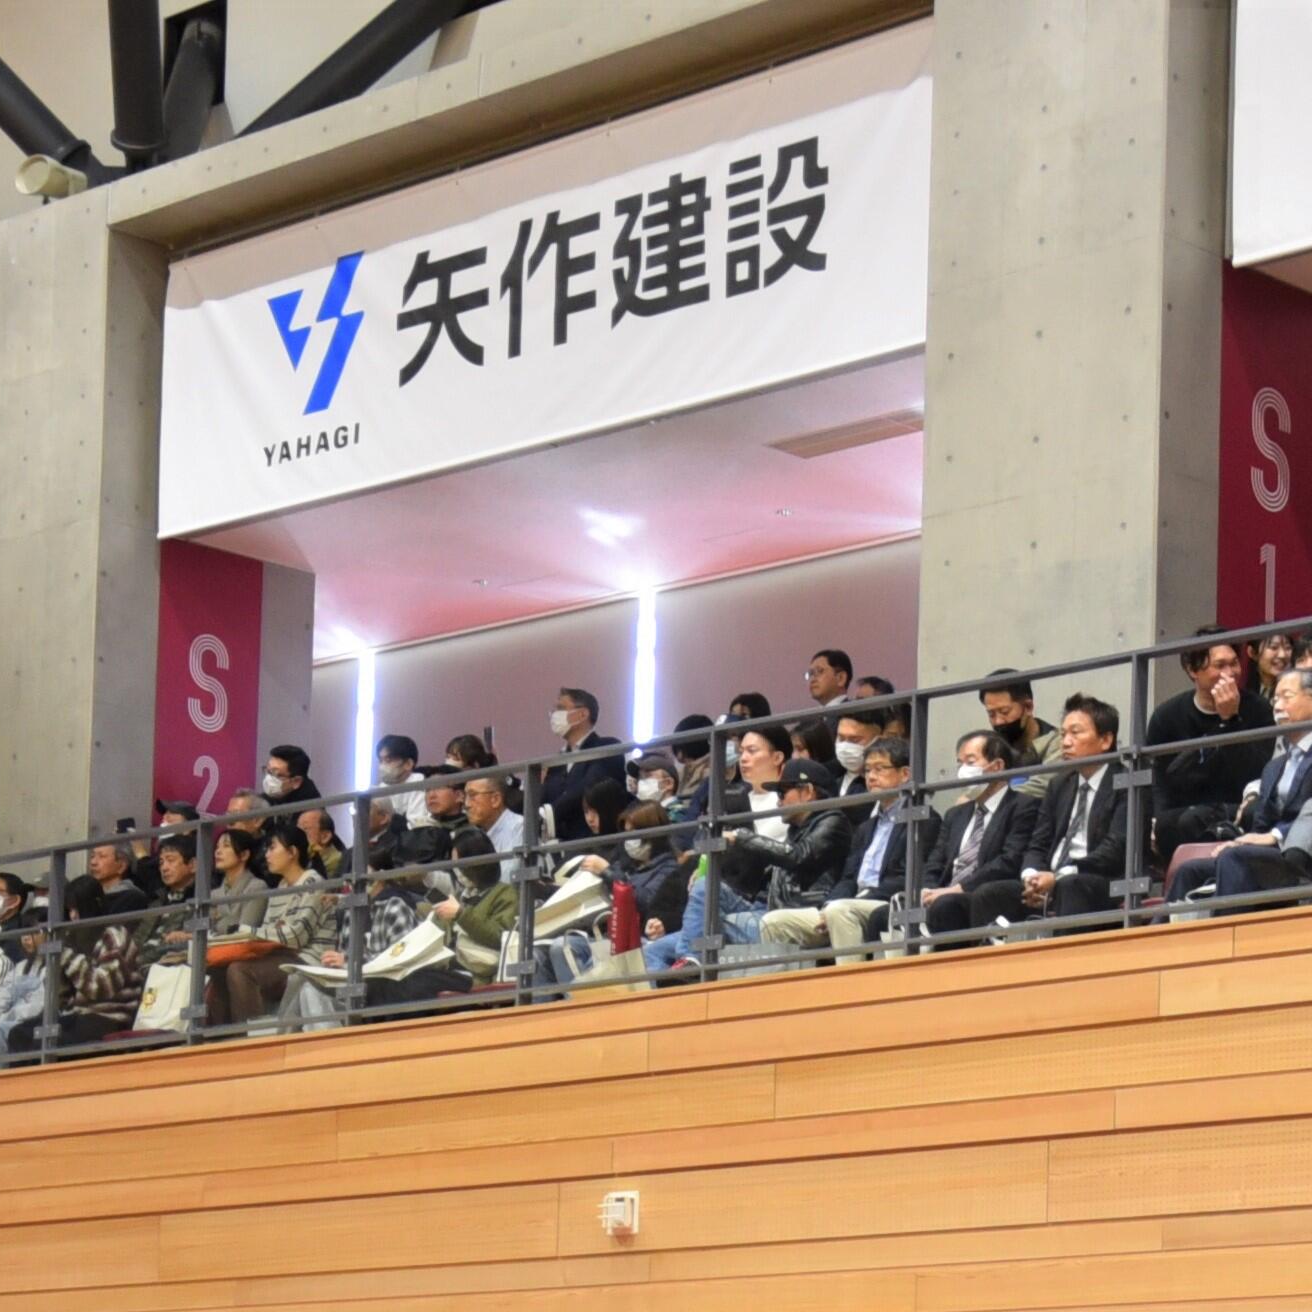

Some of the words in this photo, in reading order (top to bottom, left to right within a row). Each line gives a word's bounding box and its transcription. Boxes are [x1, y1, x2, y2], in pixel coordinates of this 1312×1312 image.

[396, 136, 830, 388] 矢作建設
[263, 421, 360, 467] YAHAGI
